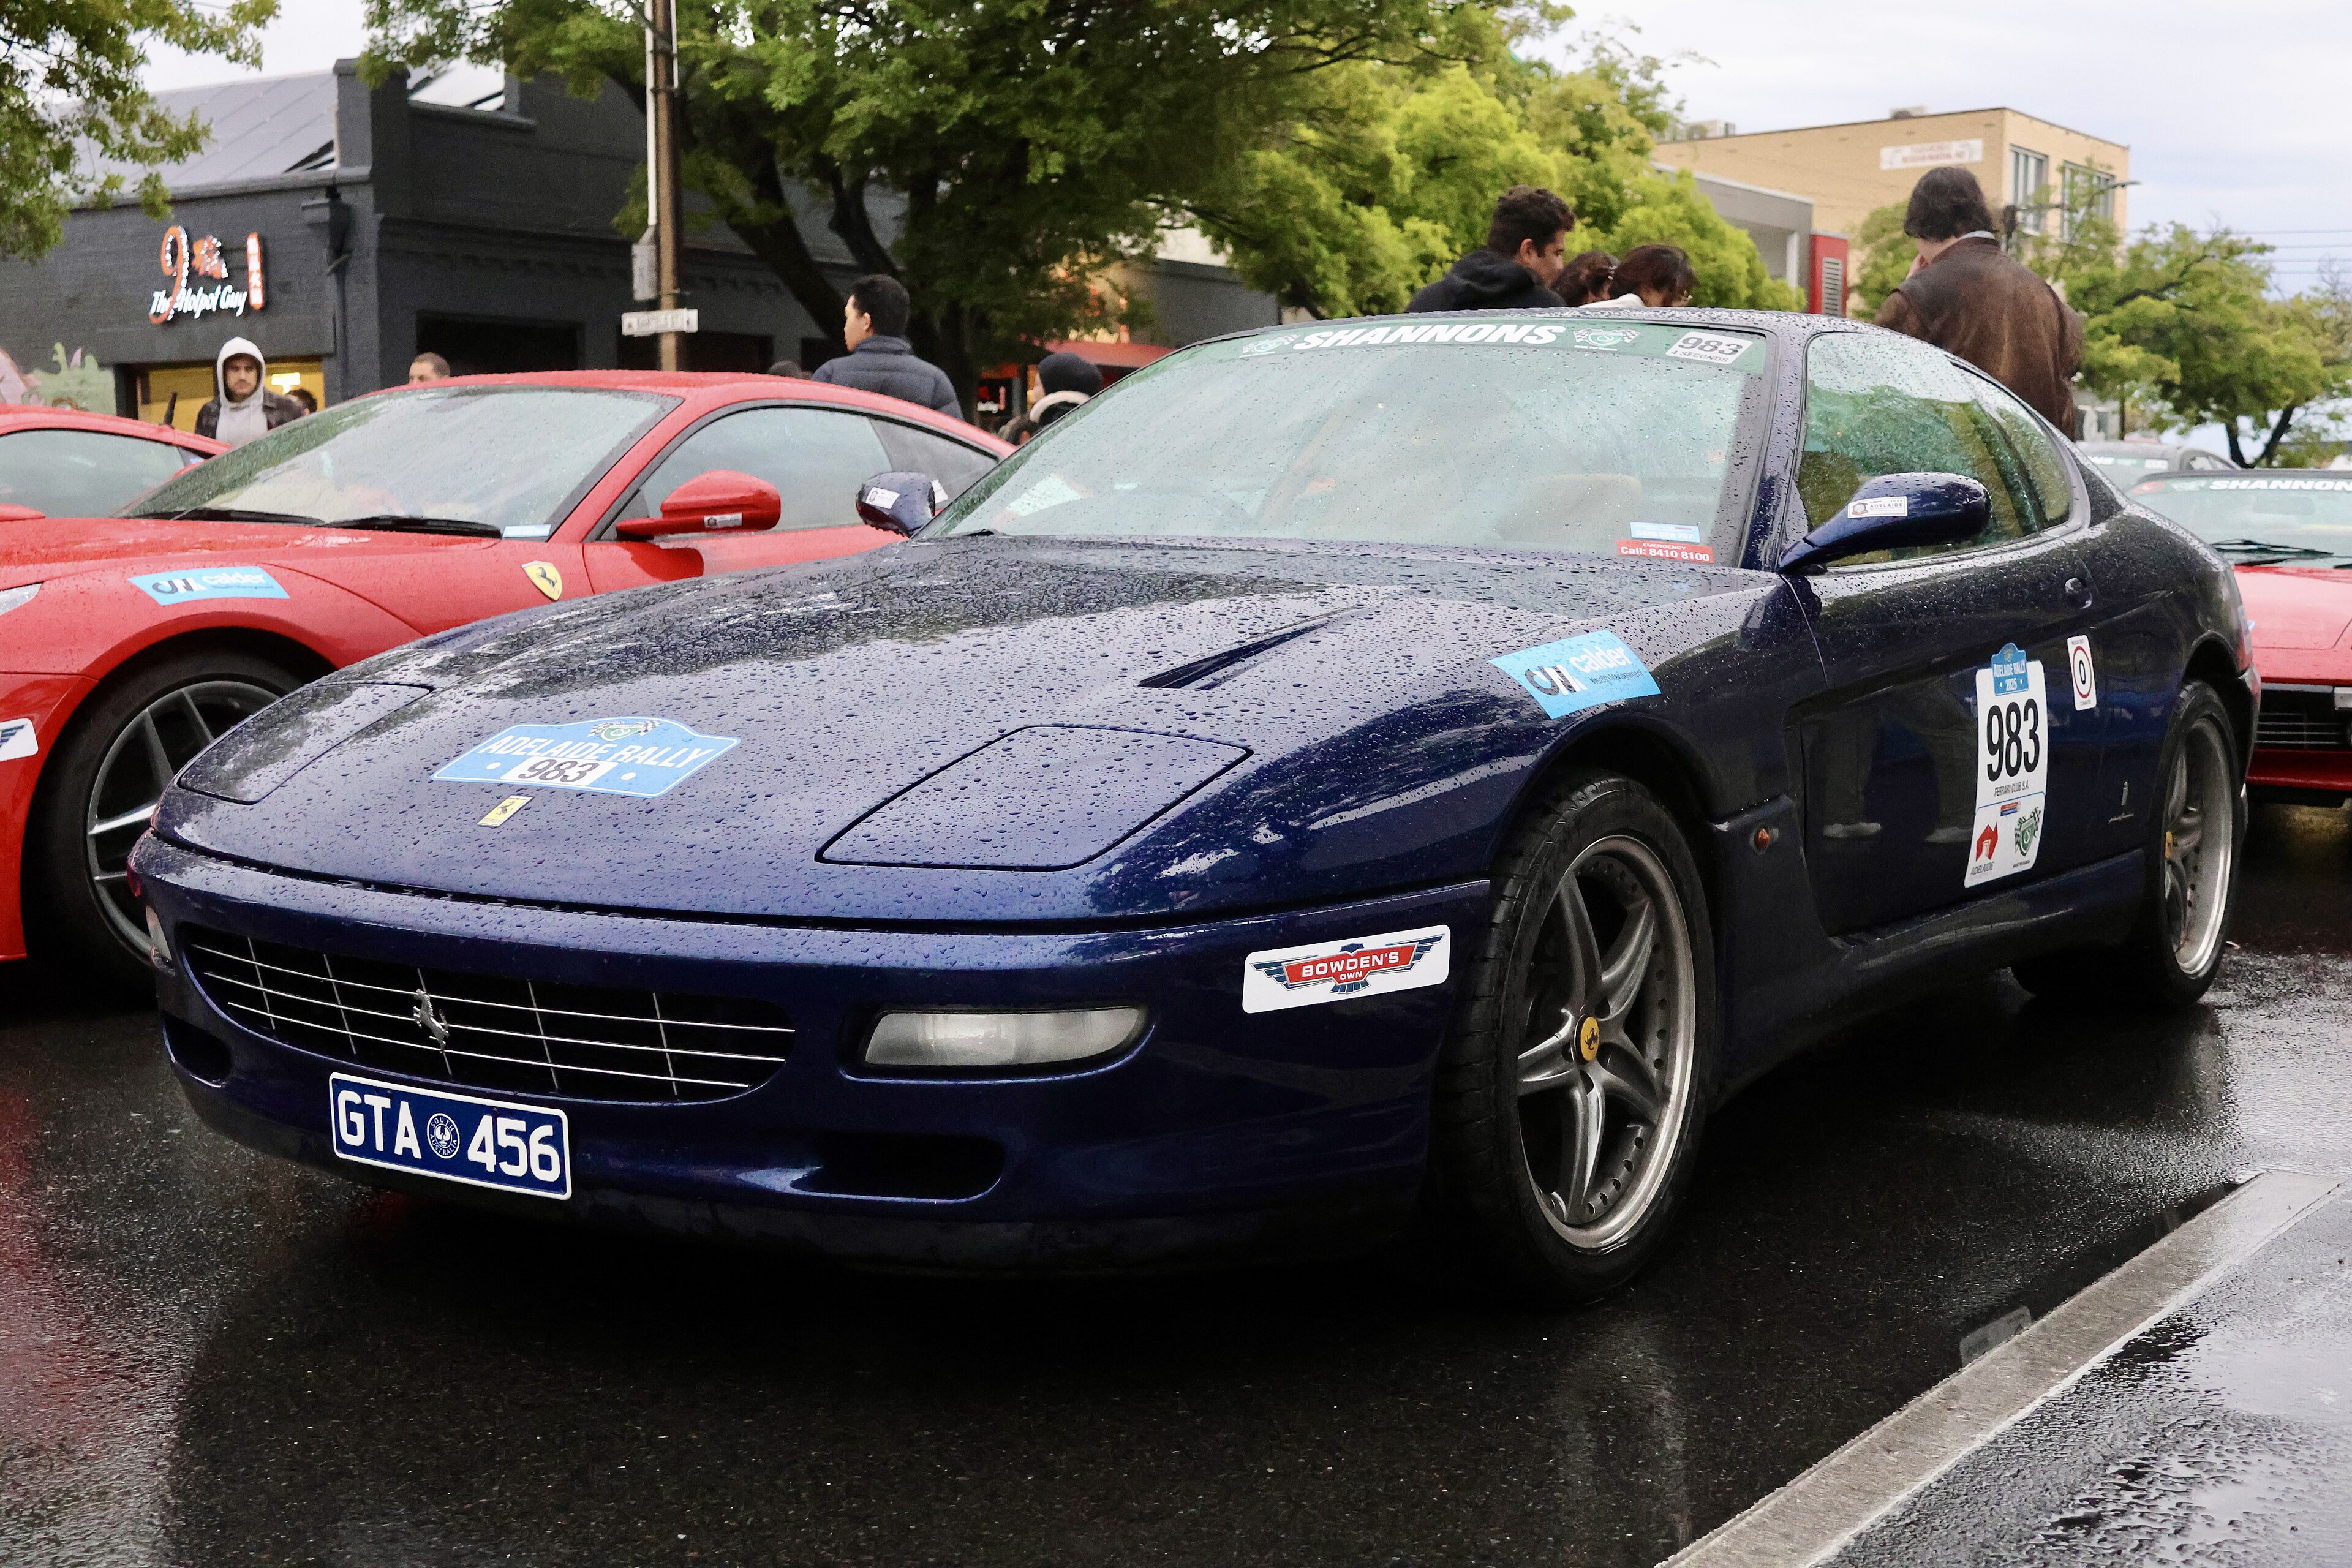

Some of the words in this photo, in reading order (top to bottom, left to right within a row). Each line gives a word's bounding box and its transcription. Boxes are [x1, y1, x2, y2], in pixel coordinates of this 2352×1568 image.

[219, 284, 247, 317] Guy
[1292, 324, 1566, 350] SHANNONS
[1678, 337, 1743, 355] 983
[1679, 351, 1729, 362] SECONDS
[1620, 546, 1647, 556] Call:
[1649, 548, 1678, 559] 8410
[1681, 551, 1710, 562] 8100
[1569, 646, 1632, 673] calder
[1589, 673, 1610, 685] Wealth
[1610, 669, 1645, 682] Management
[1986, 698, 2040, 782] 983
[478, 735, 619, 760] ADELAIDE
[611, 745, 715, 769] RALLY
[518, 759, 600, 783] 983
[1994, 784, 2011, 796] FERRARI
[2011, 782, 2021, 793] CLUB
[1970, 861, 1994, 876] ADELAIDE
[1302, 951, 1400, 978] BOWDEN'S
[1340, 971, 1362, 981] OWN
[431, 1117, 454, 1132] SOUTH
[337, 1090, 422, 1159] GTA
[467, 1115, 560, 1182] 456
[430, 1134, 458, 1155] AUSTRALIA
